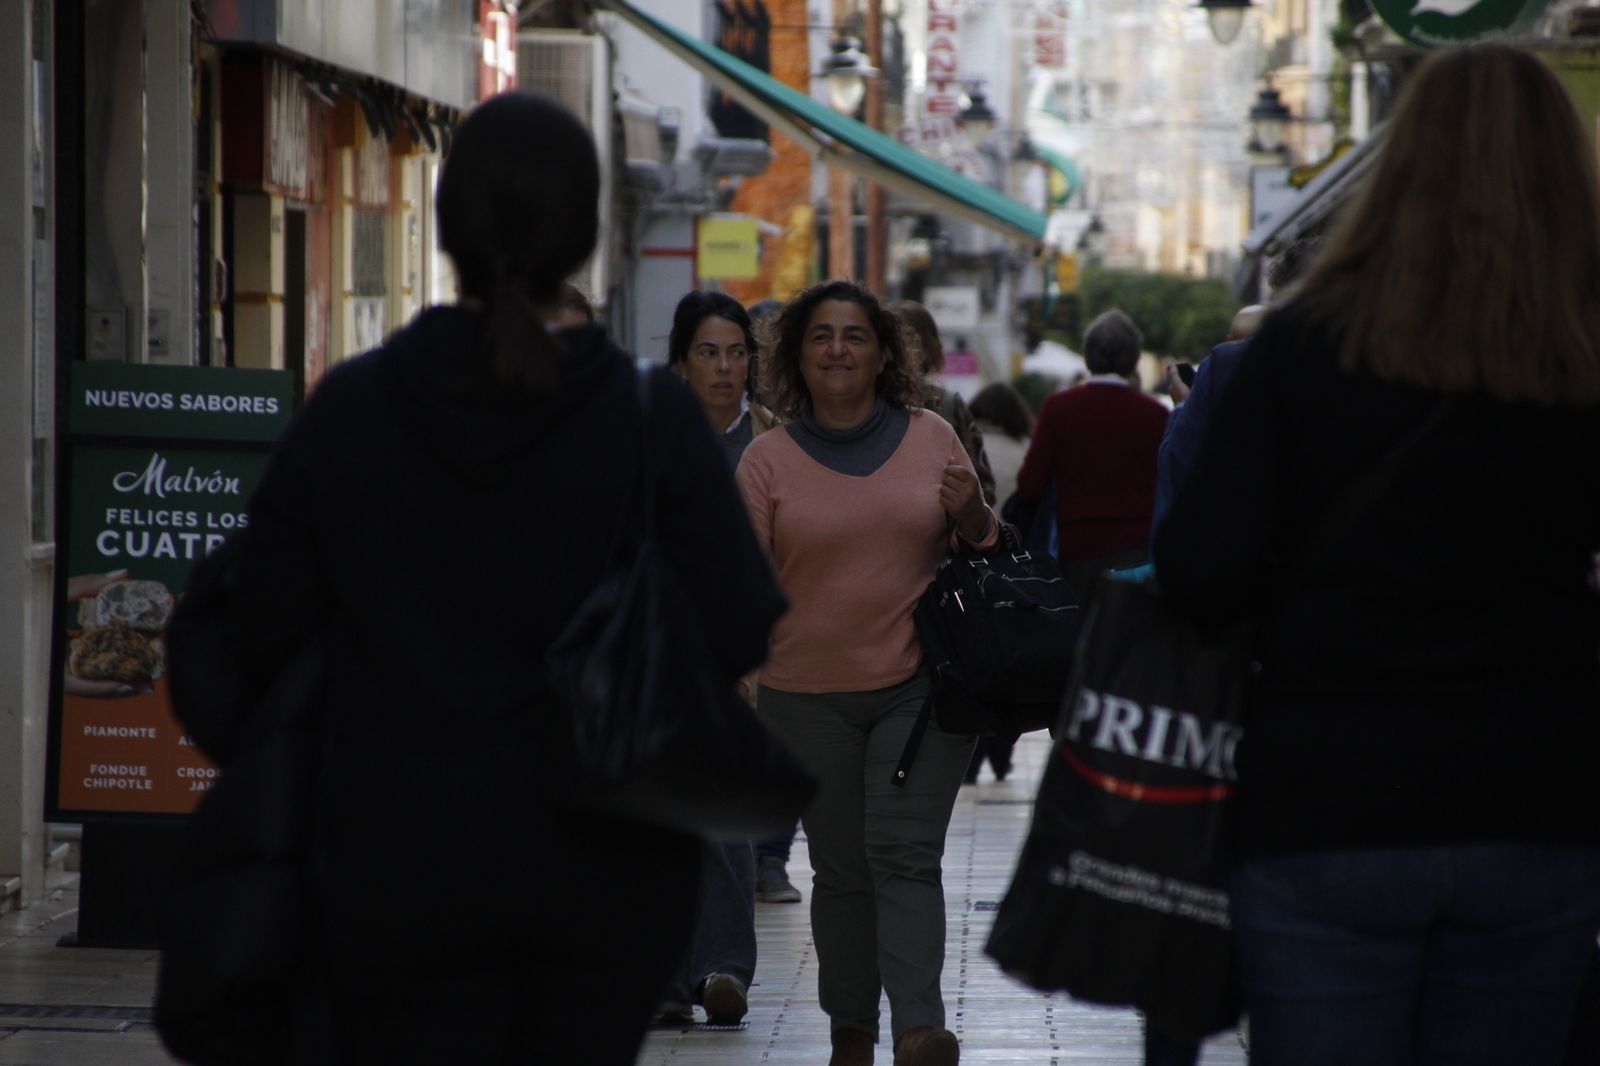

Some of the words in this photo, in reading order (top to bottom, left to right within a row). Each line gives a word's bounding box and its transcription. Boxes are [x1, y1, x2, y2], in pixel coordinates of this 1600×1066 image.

[85, 389, 174, 409] NUEVOS
[179, 393, 279, 414] SABORES
[112, 452, 240, 498] Malvón
[105, 507, 198, 527] FELICES
[207, 511, 249, 529] LOS
[83, 725, 156, 739] PIAMONTE
[89, 764, 147, 777] FONDUE
[83, 778, 153, 790] CHIPOTLE
